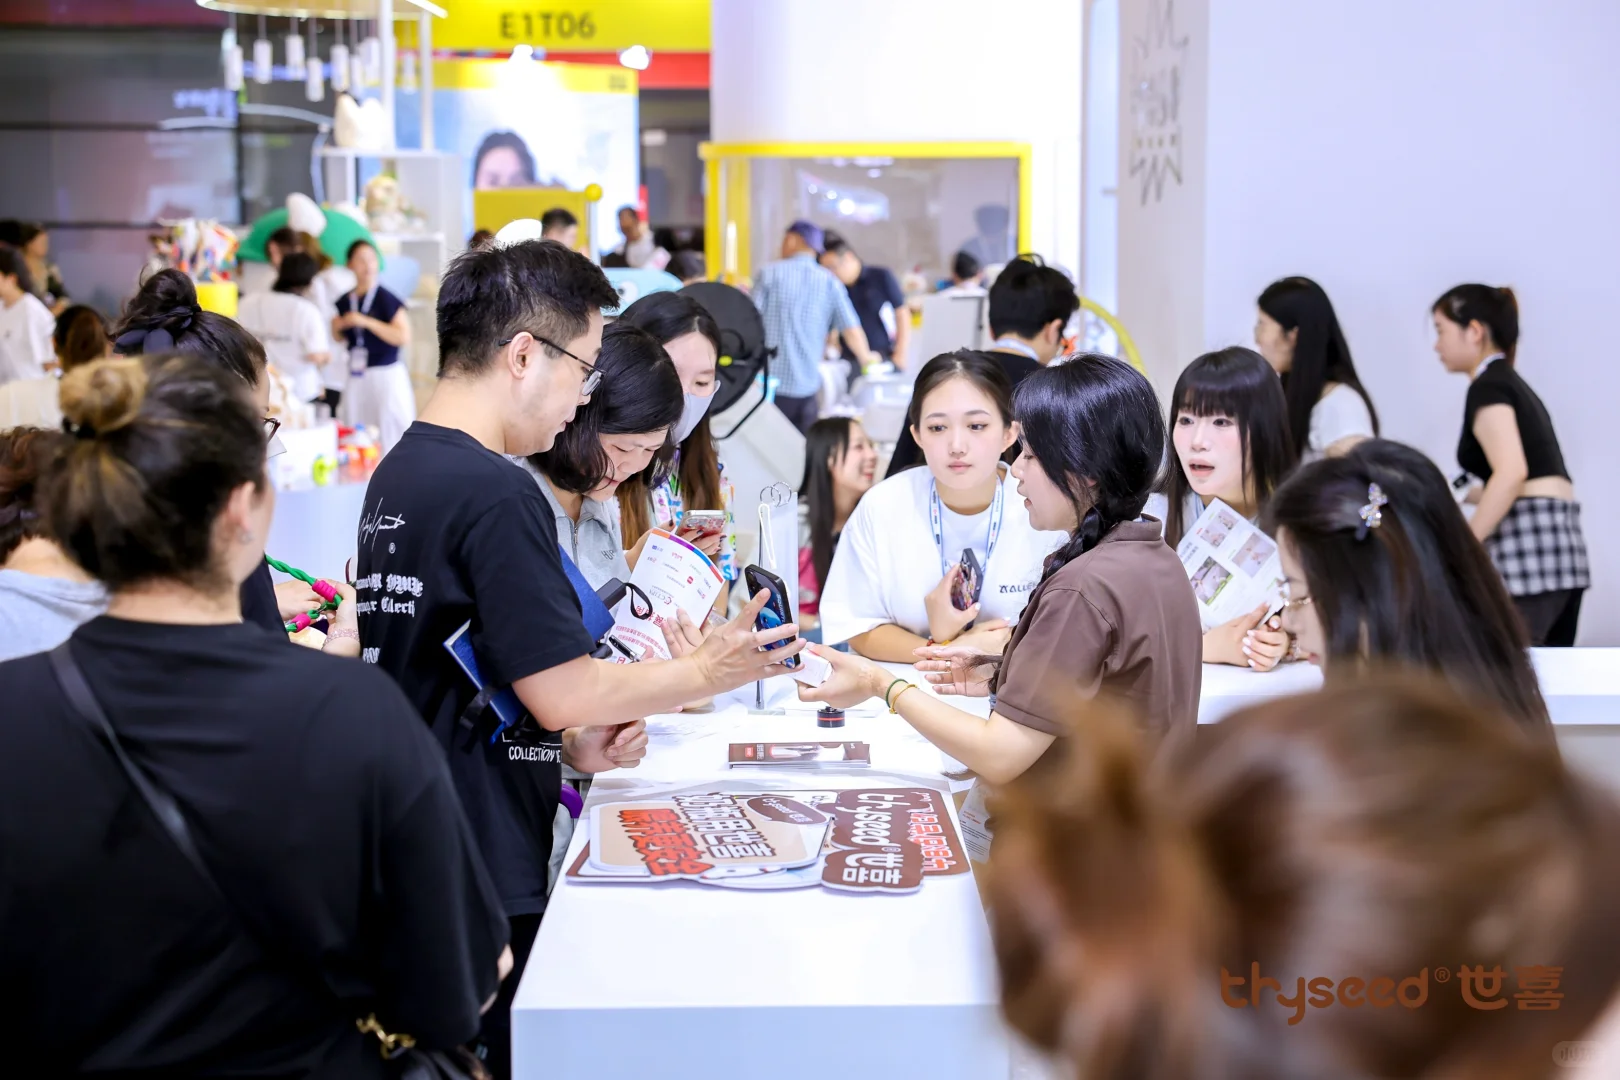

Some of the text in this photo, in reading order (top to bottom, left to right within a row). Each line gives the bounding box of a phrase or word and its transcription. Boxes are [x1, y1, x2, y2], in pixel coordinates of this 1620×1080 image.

[499, 11, 597, 39] E1T06
[673, 793, 775, 858] 奶瓶用世喜
[843, 852, 904, 885] 世喜
